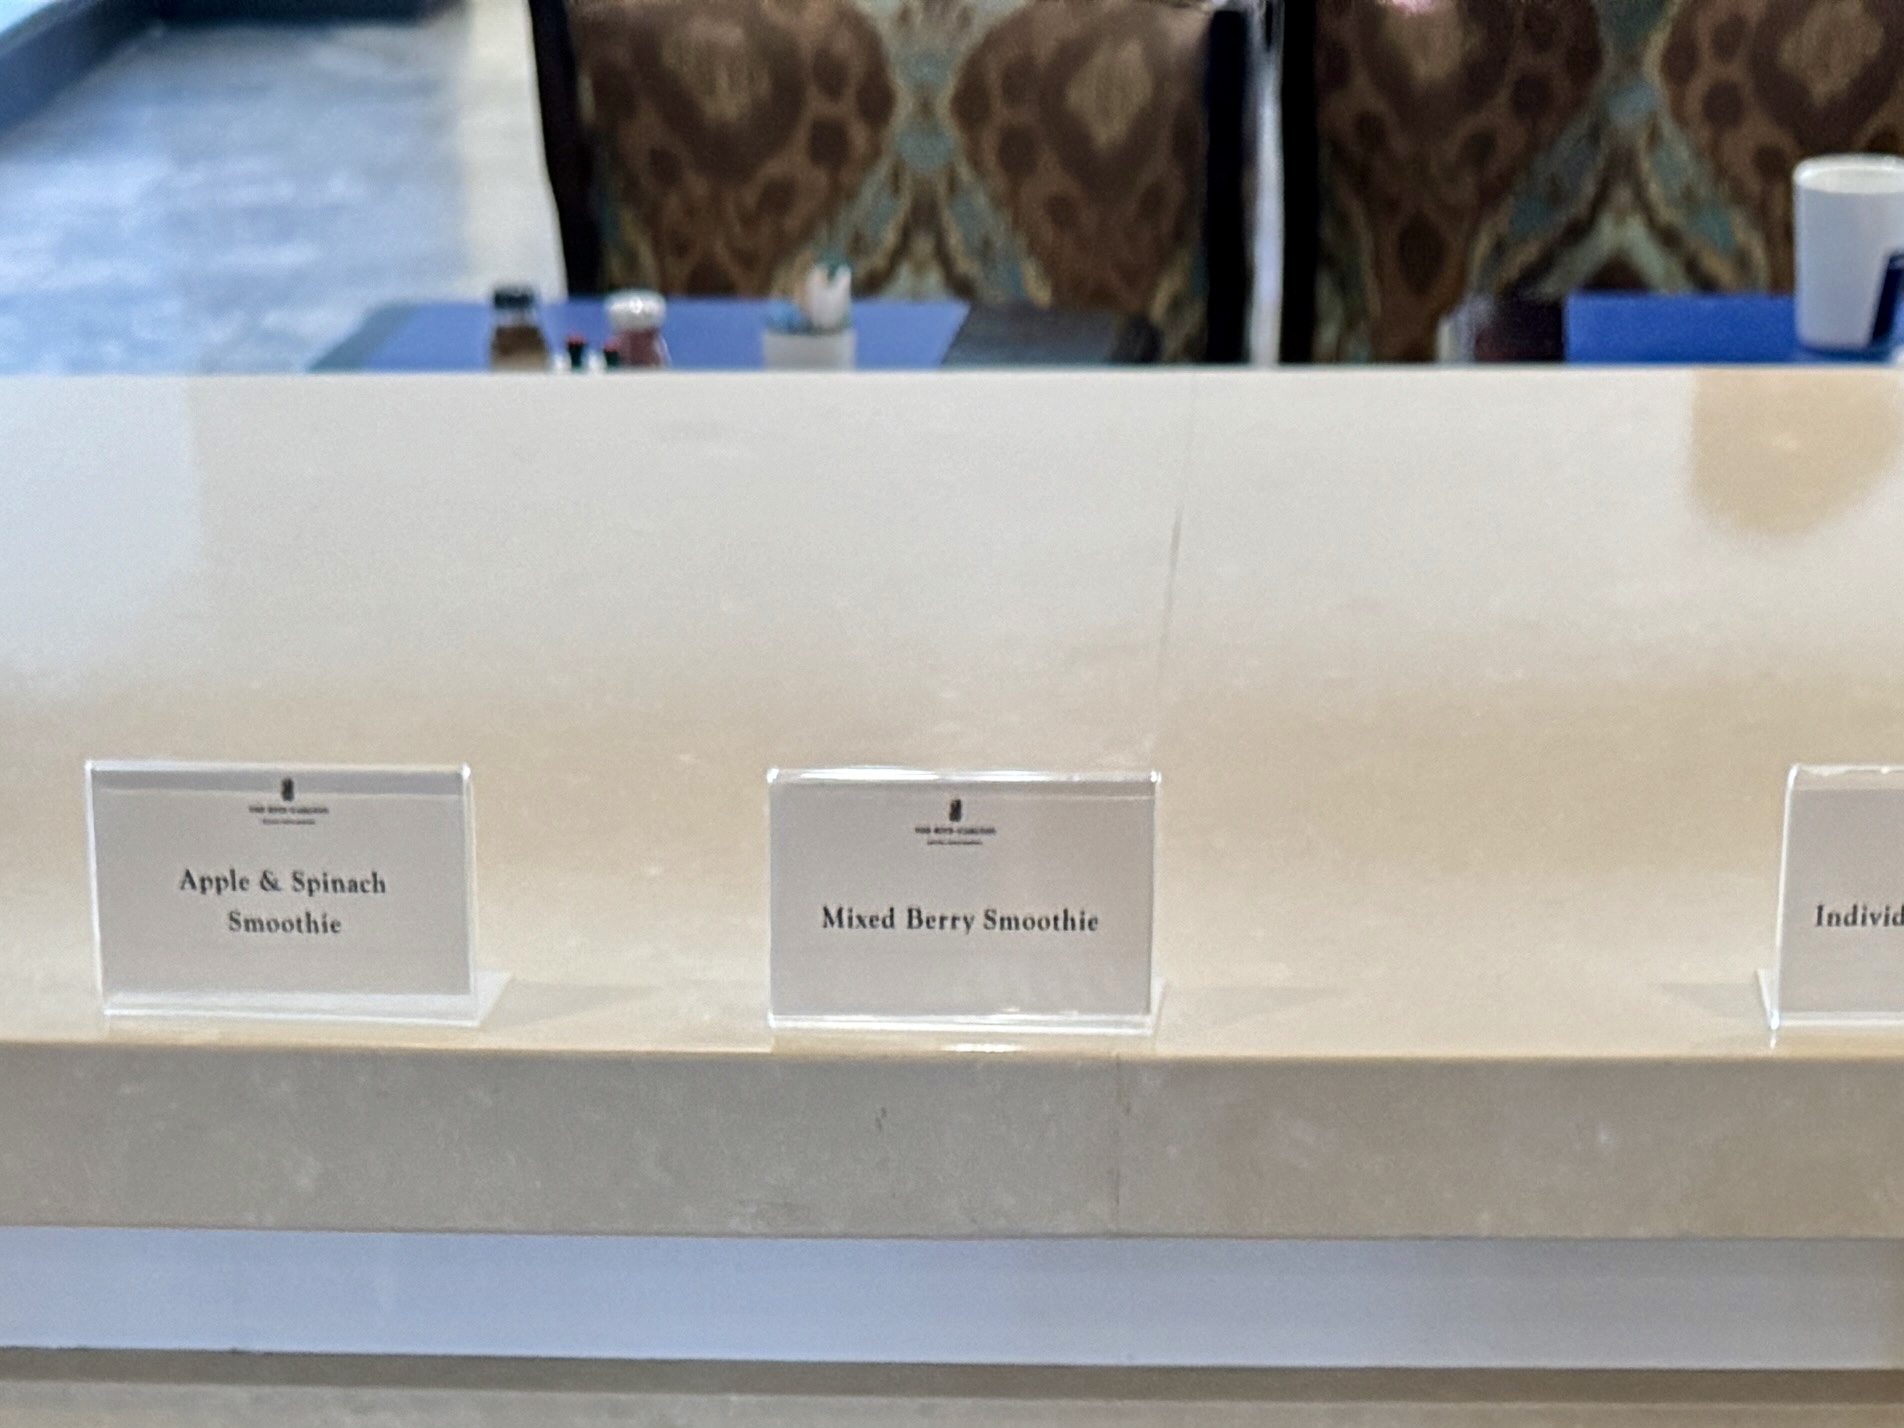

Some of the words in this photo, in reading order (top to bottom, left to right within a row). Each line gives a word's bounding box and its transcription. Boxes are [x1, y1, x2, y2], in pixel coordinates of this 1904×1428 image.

[180, 868, 250, 895] Apple
[260, 871, 281, 893] &
[292, 870, 386, 896] Spinach
[229, 909, 342, 935] Smoothie
[822, 906, 895, 930] Mixed
[907, 907, 975, 935] Berry
[983, 908, 1099, 932] Smoothie
